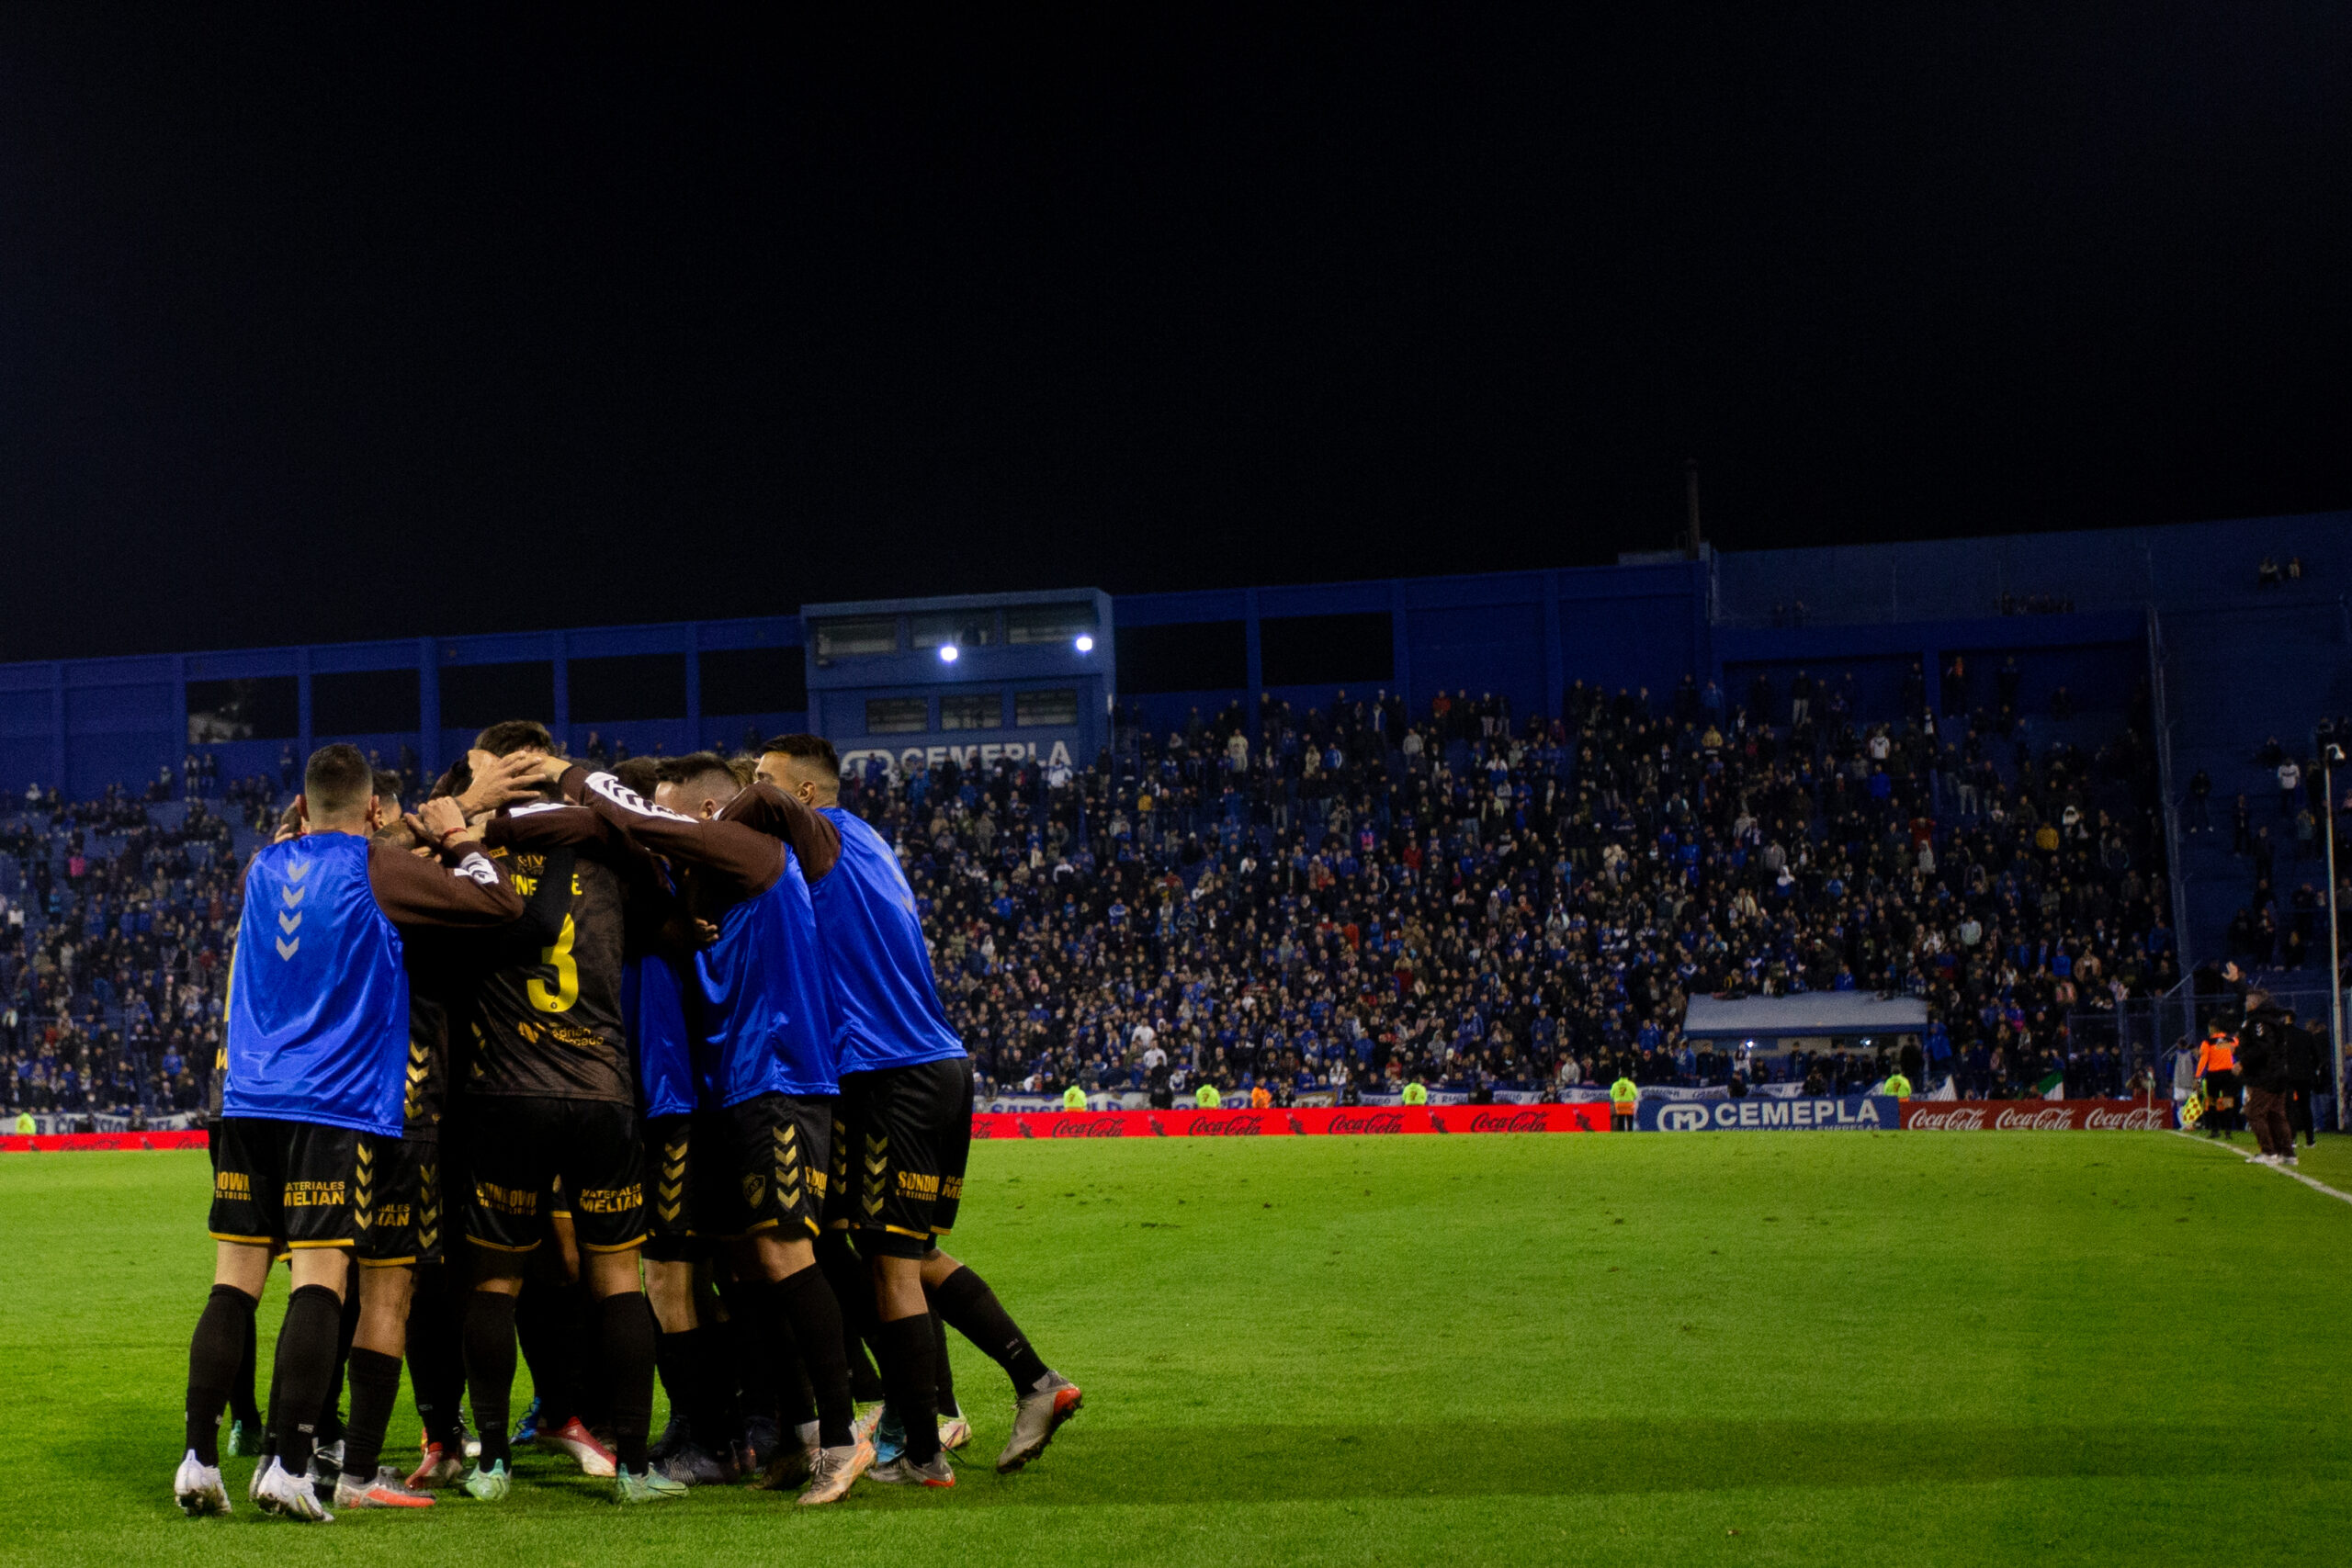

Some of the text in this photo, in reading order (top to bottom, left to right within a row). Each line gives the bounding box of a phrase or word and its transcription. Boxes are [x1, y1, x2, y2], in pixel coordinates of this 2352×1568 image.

[526, 913, 579, 1013] 3
[1714, 1099, 1880, 1126] CEMEPLA
[1907, 1108, 1988, 1131] Coca-Cola
[1996, 1107, 2075, 1131] Coca-Cola
[2085, 1107, 2165, 1131] Coca-Cola
[284, 1180, 345, 1191] ATERIALES
